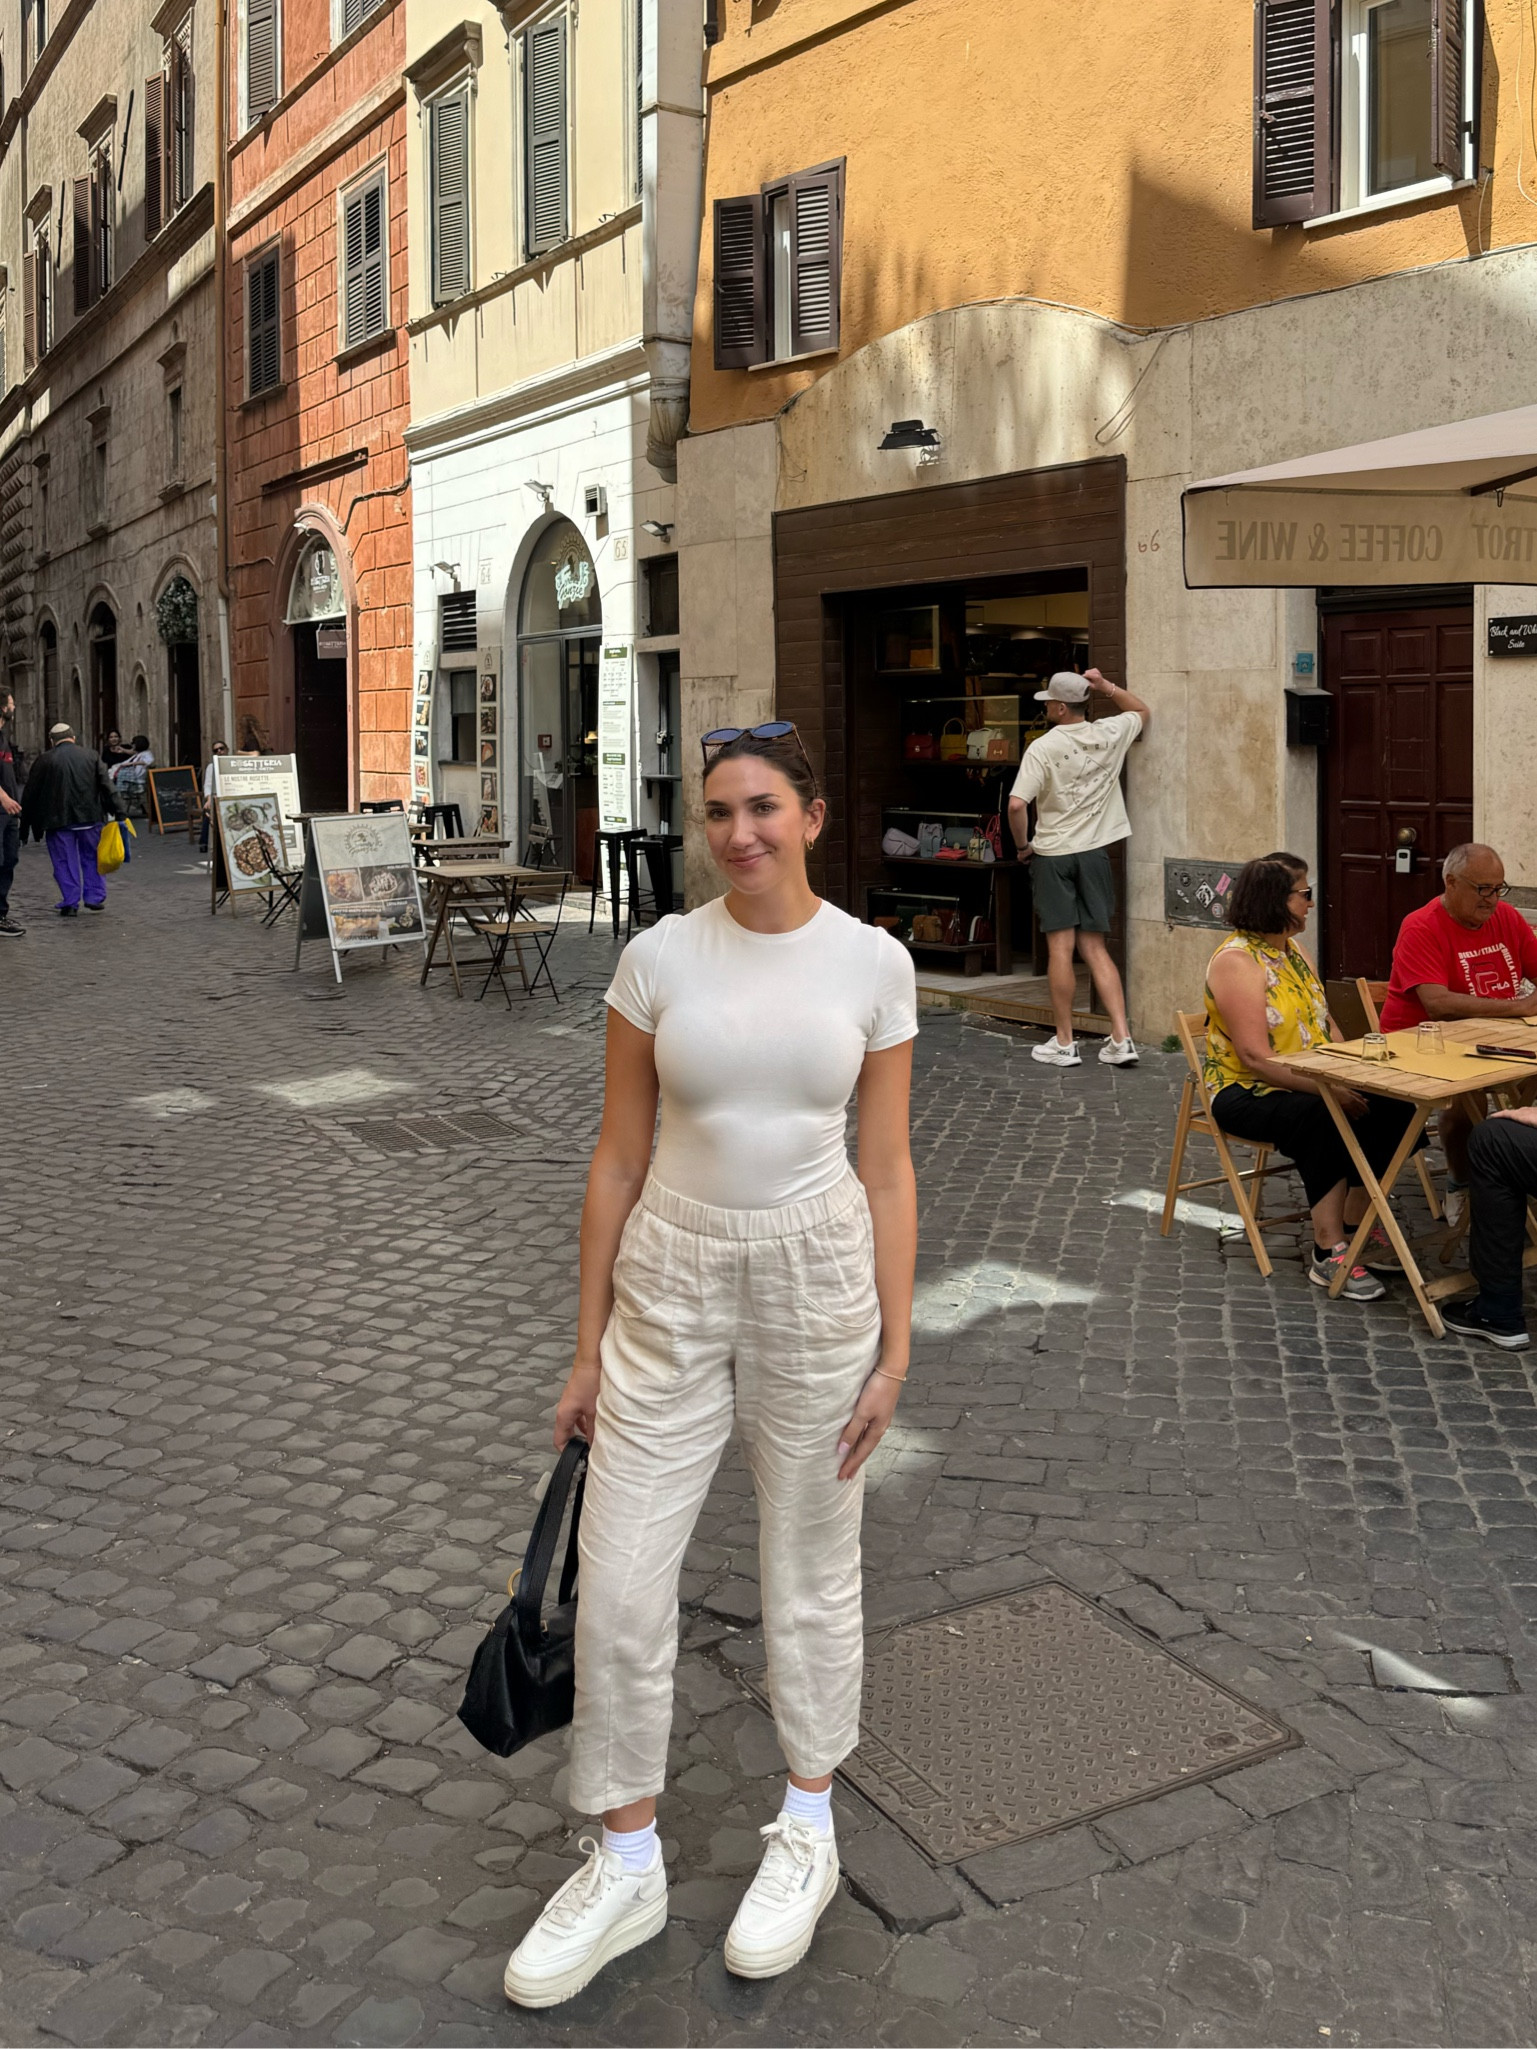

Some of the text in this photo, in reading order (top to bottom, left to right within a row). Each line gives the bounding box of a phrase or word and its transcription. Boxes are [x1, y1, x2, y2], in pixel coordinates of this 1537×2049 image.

[615, 541, 627, 558] 65
[1490, 626, 1508, 638] Black
[1509, 625, 1523, 636] and
[1508, 639, 1525, 649] Suite
[1481, 942, 1506, 955] ITALIA
[1501, 948, 1516, 971] BIELLA
